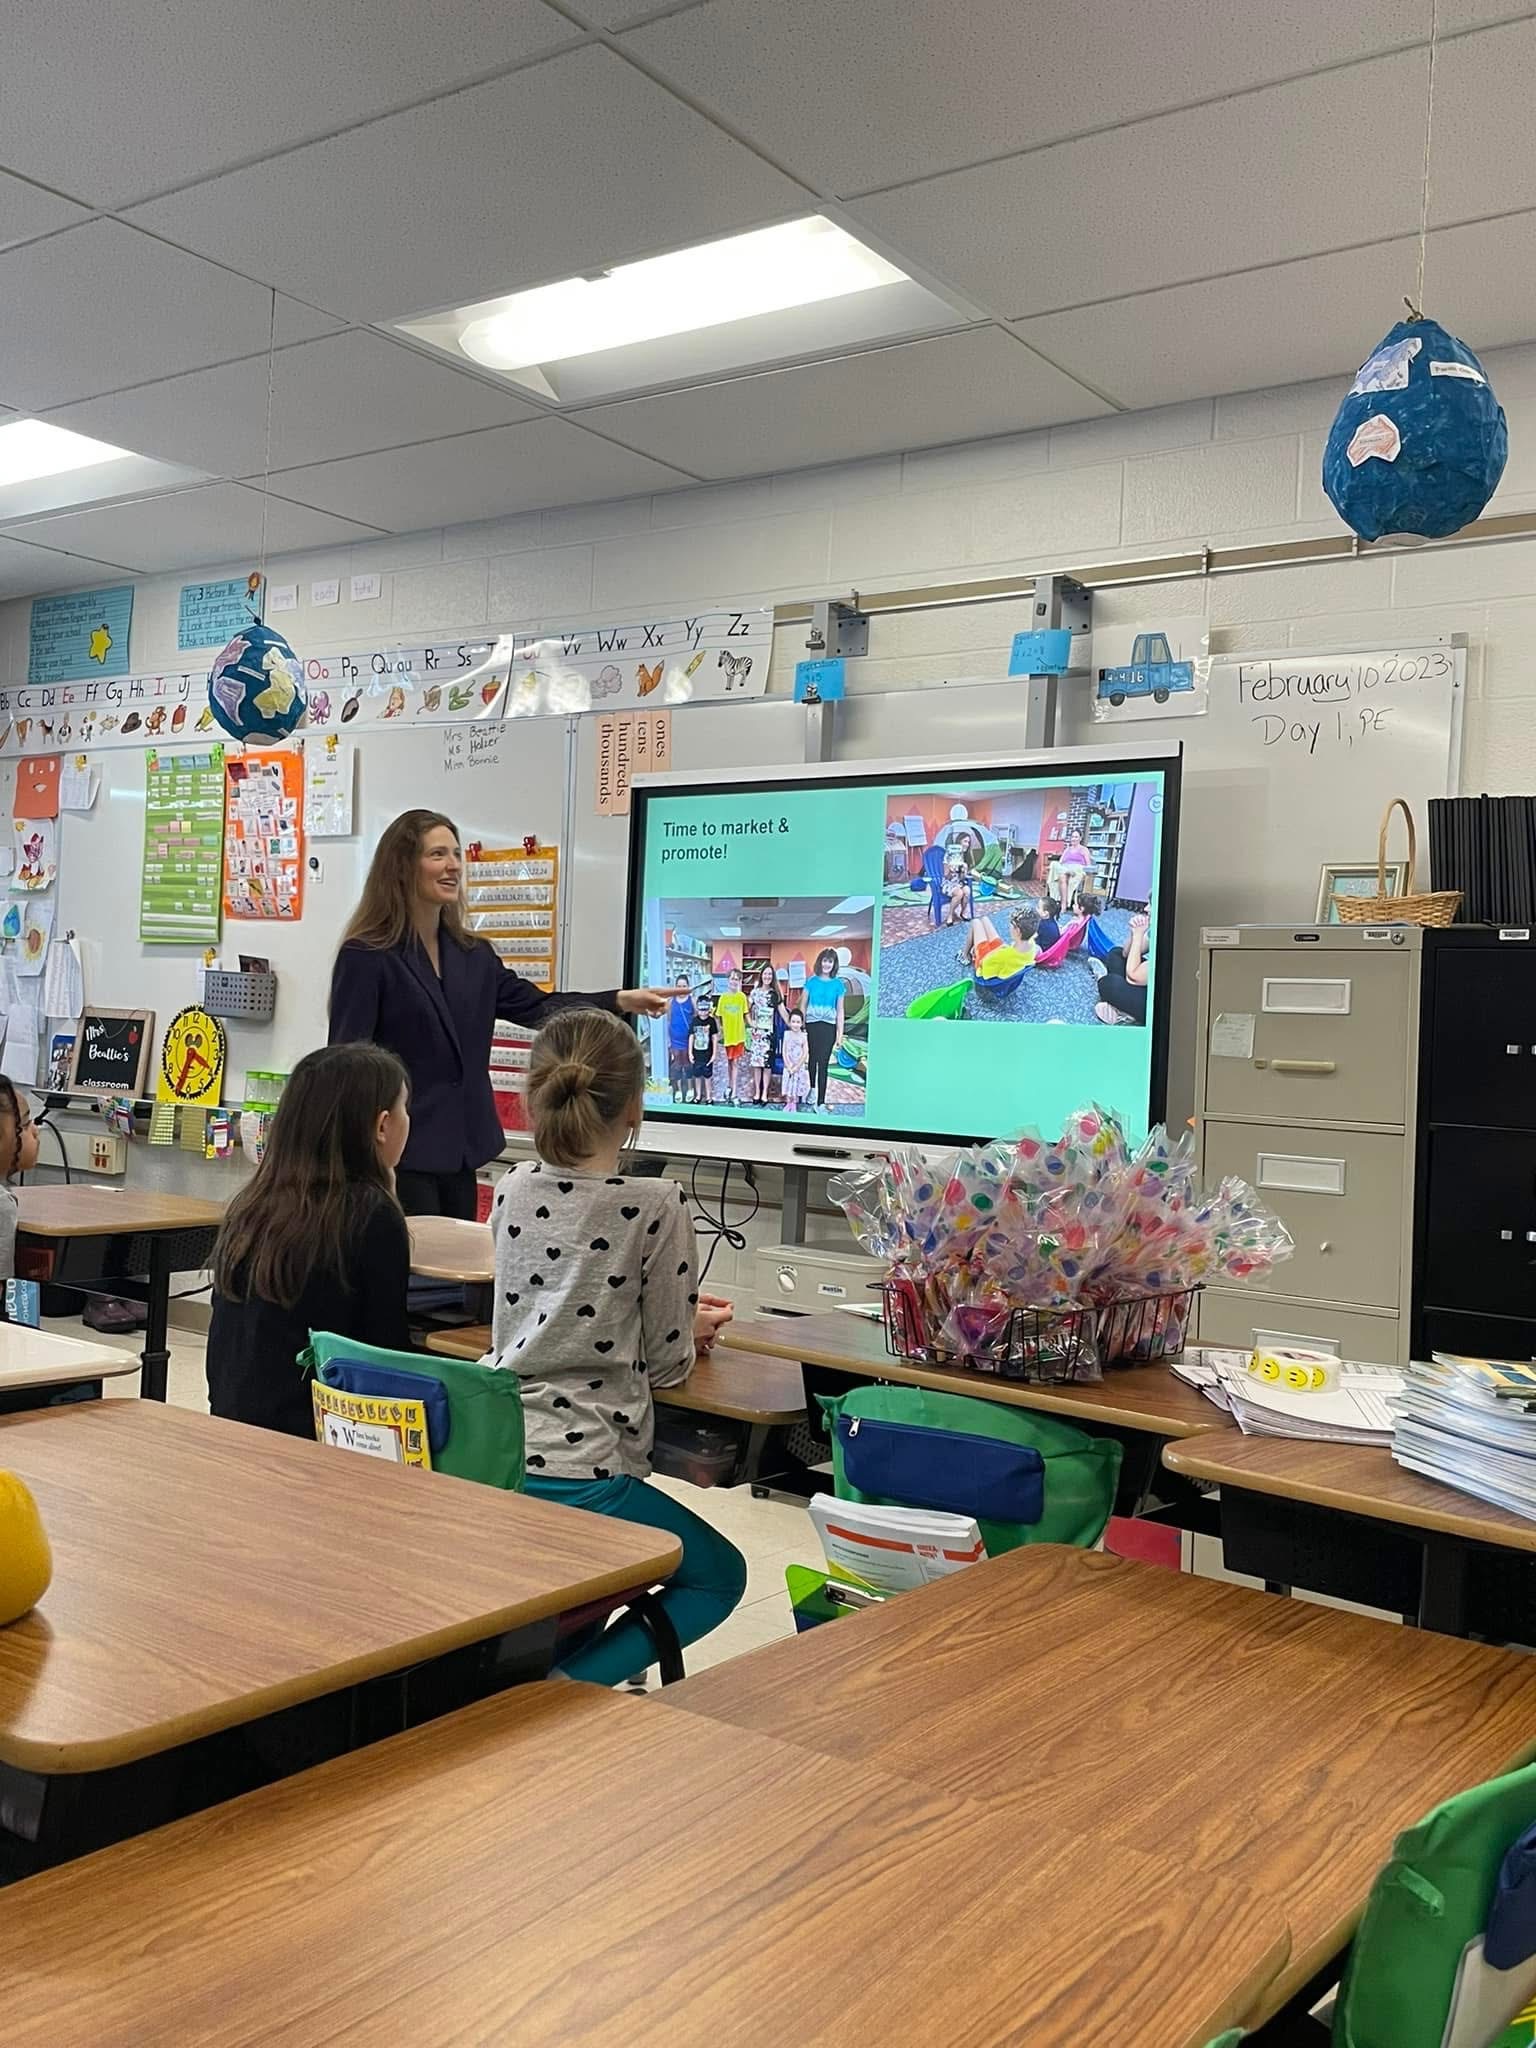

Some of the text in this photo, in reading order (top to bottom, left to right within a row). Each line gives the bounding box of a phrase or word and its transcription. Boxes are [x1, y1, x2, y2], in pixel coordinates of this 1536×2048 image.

[197, 587, 204, 601] 3
[561, 614, 750, 656] Vv Ww Xx Yy Zz
[307, 659, 329, 680] Oo
[342, 656, 359, 684] Pp
[425, 649, 440, 671] Rr
[457, 646, 472, 667] Ss
[1239, 653, 1449, 703] February 10 2023
[17, 690, 31, 708] Cc
[42, 688, 55, 707] Dd
[62, 686, 75, 704] Ee
[85, 683, 99, 702] Ff
[105, 682, 123, 707] Gg
[129, 680, 144, 698] Hh
[153, 677, 166, 696] Ii
[178, 675, 190, 702] Jj
[637, 721, 647, 754] tens
[656, 719, 666, 758] ones
[1252, 714, 1321, 754] Day
[1359, 708, 1394, 736] PE
[600, 723, 614, 805] thousands
[616, 722, 631, 797] hundreds
[663, 817, 790, 837] Time to market &
[661, 844, 728, 864] promote!
[183, 1015, 189, 1027] 11
[192, 1013, 200, 1024] 12
[172, 1028, 181, 1040] 10
[211, 1031, 217, 1043] 2
[167, 1045, 173, 1056] 9
[213, 1049, 219, 1060] 3
[168, 1062, 174, 1074] 8
[82, 1078, 129, 1089] classroom
[186, 1082, 191, 1094] 6
[198, 1079, 204, 1090] 5
